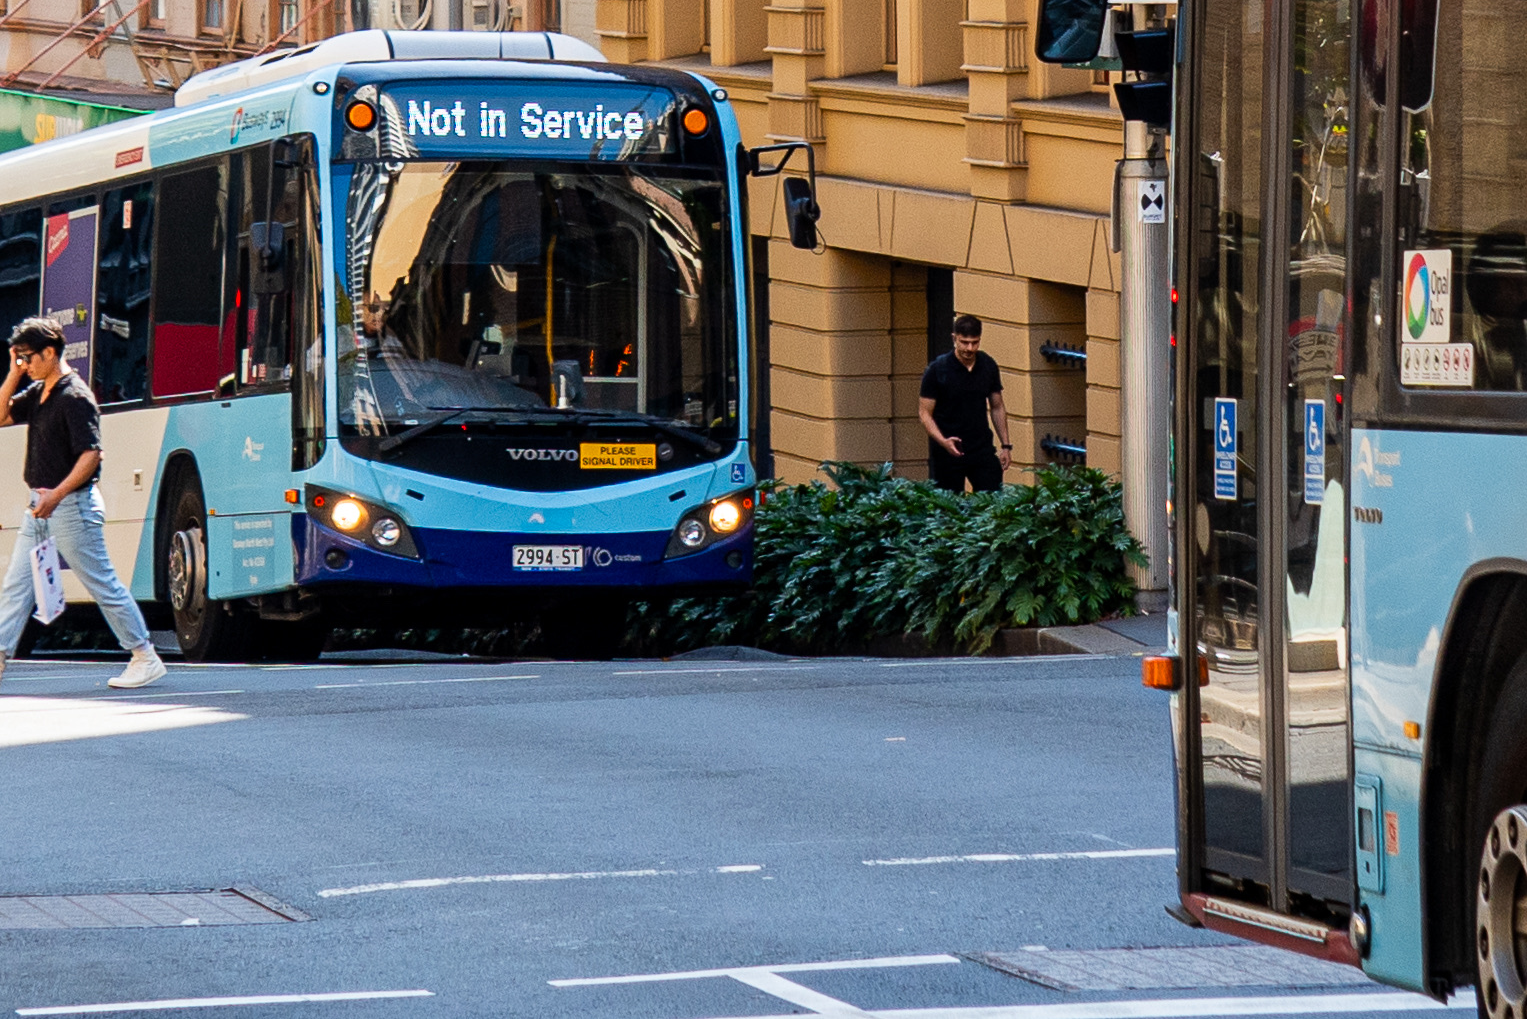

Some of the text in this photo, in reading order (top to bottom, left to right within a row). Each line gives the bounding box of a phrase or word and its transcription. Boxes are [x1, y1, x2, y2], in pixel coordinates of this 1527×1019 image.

[407, 100, 644, 140] Not in Service
[1430, 269, 1449, 302] Opal
[1430, 299, 1444, 326] bus
[506, 448, 578, 461] VOLVO
[600, 446, 636, 455] PLEASE
[582, 457, 654, 466] SIGNAL DRIVER
